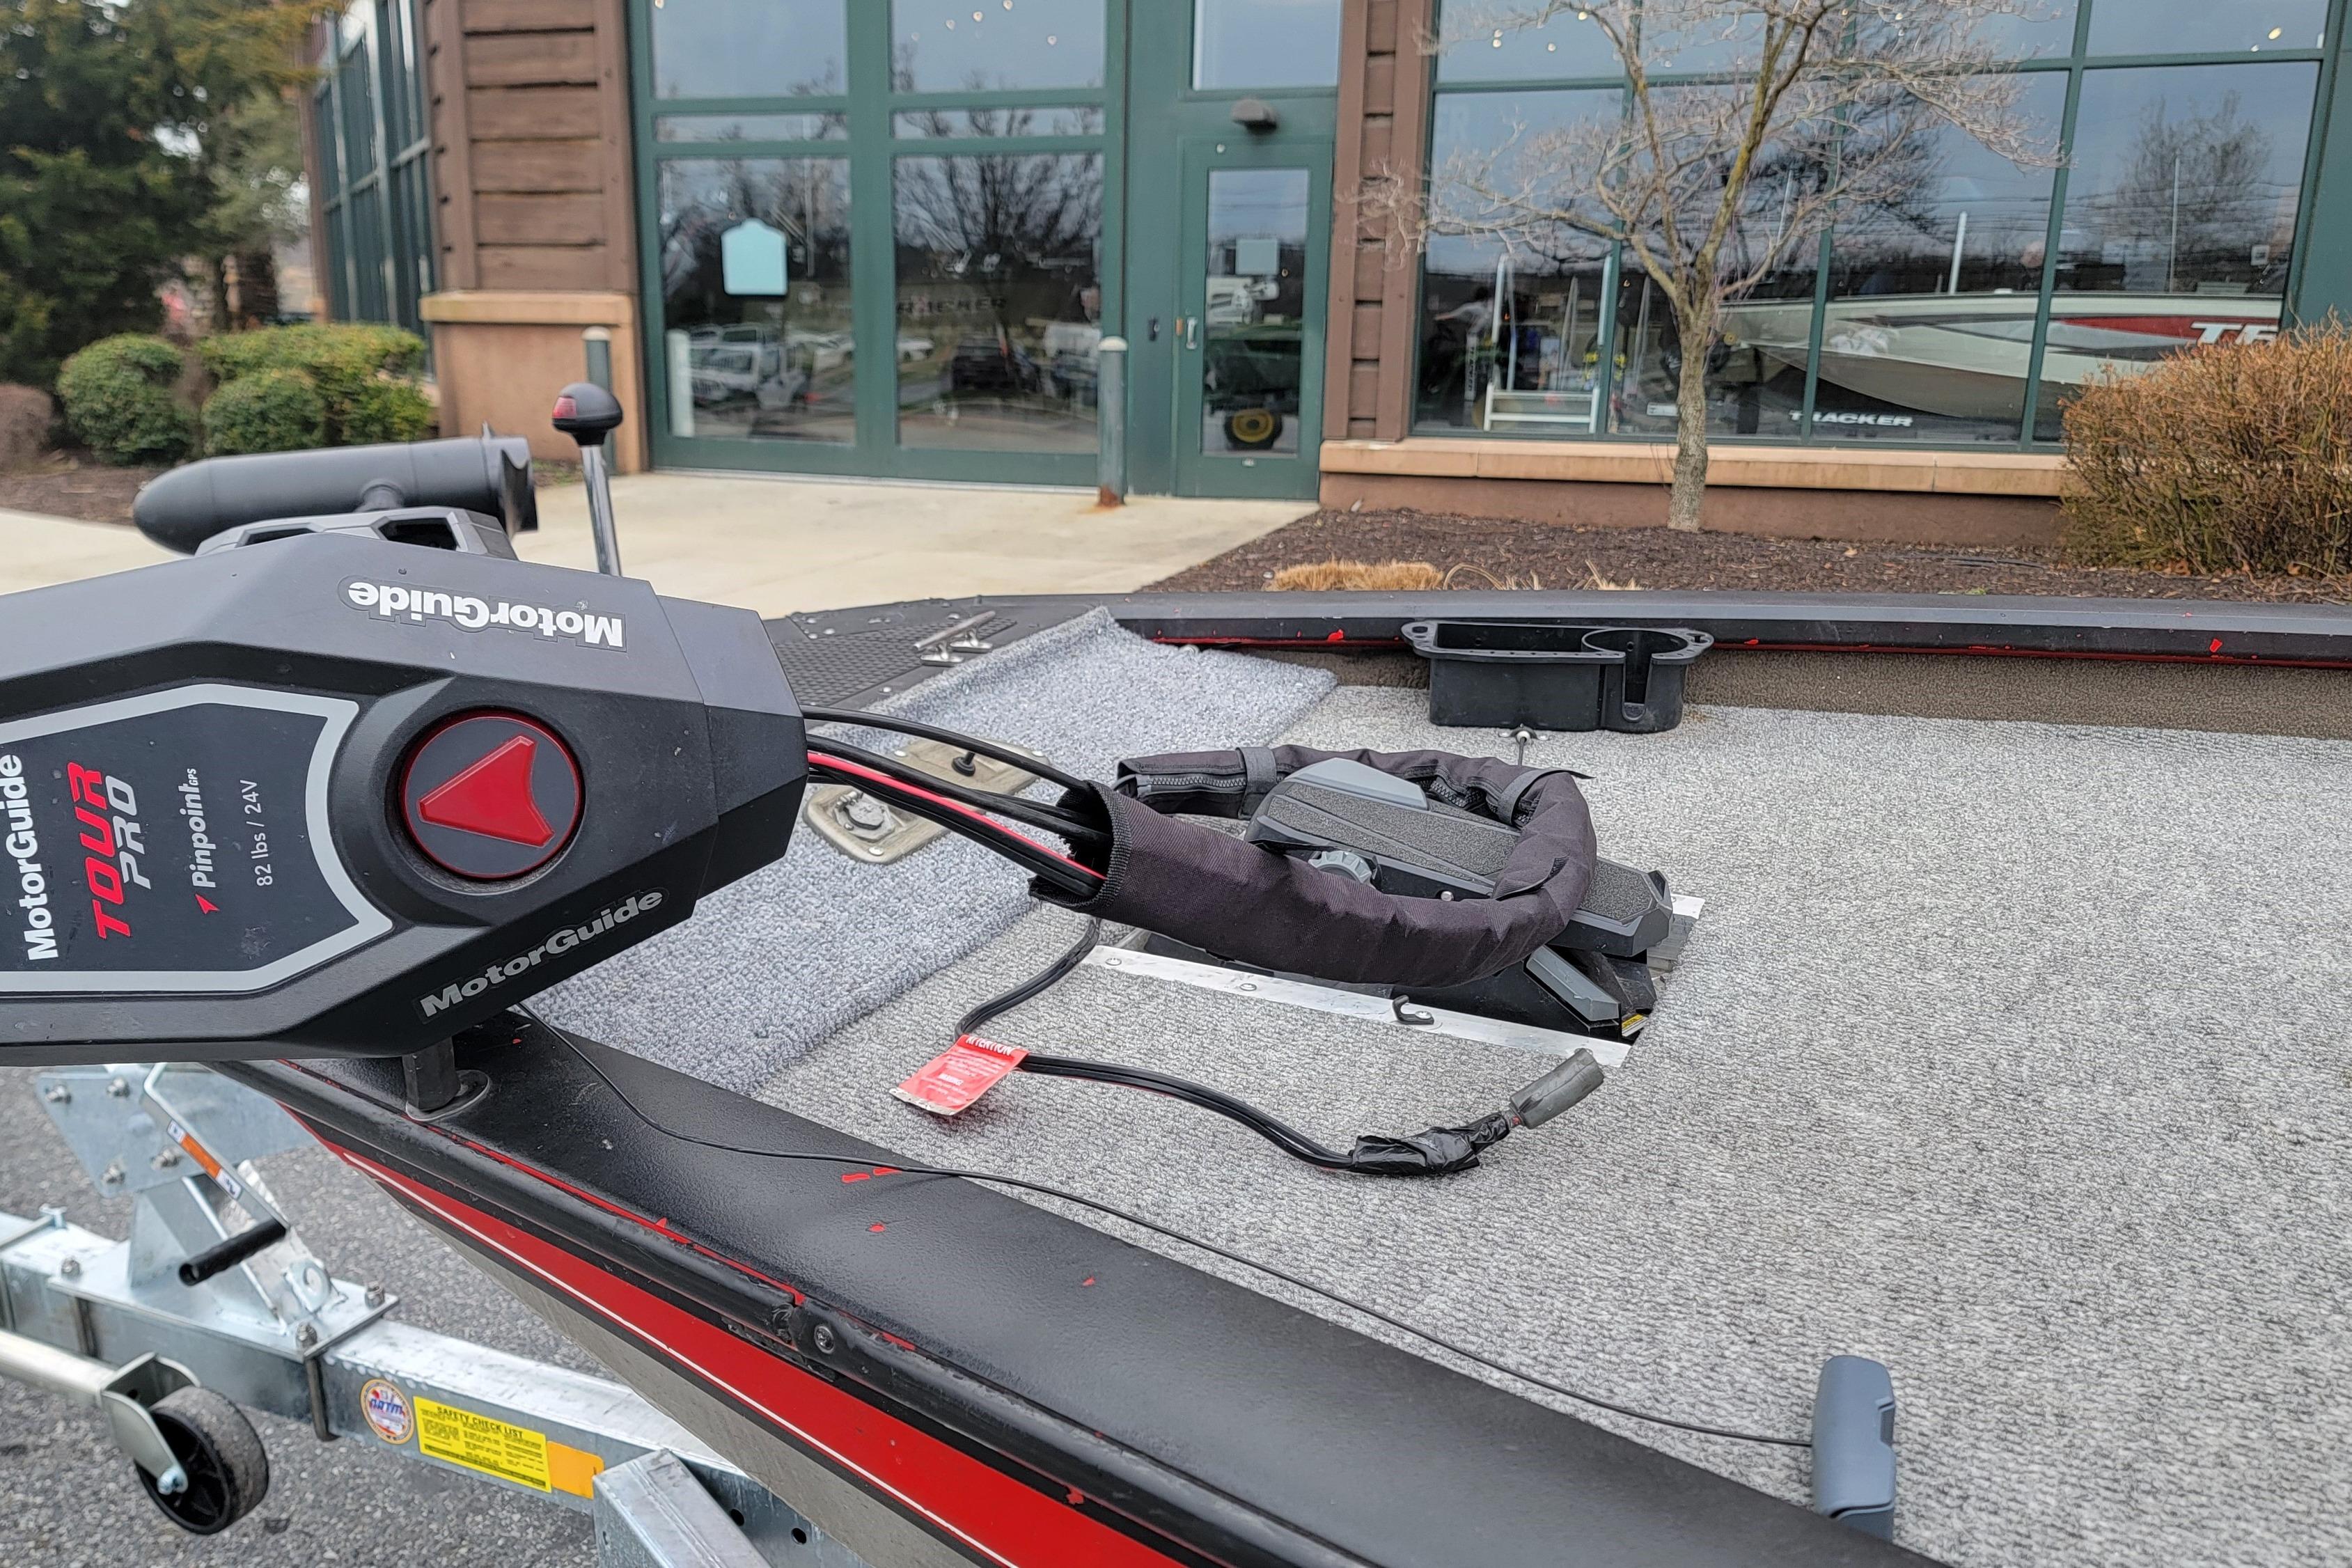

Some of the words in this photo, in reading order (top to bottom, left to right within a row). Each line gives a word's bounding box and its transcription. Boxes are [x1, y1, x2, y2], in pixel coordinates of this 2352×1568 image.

[347, 581, 623, 648] MotorGuide
[240, 779, 262, 815] 24V
[0, 754, 58, 960] MotorGuide
[68, 762, 131, 939] TOUR
[105, 775, 151, 890] PRO
[251, 832, 269, 859] lbs
[254, 863, 273, 886] 82
[420, 891, 663, 1017] MotorGuide
[965, 1035, 1014, 1056] ATTENTION
[437, 1406, 469, 1423] SAFETY
[472, 1416, 502, 1434] CHECK
[504, 1426, 523, 1439] LIST
